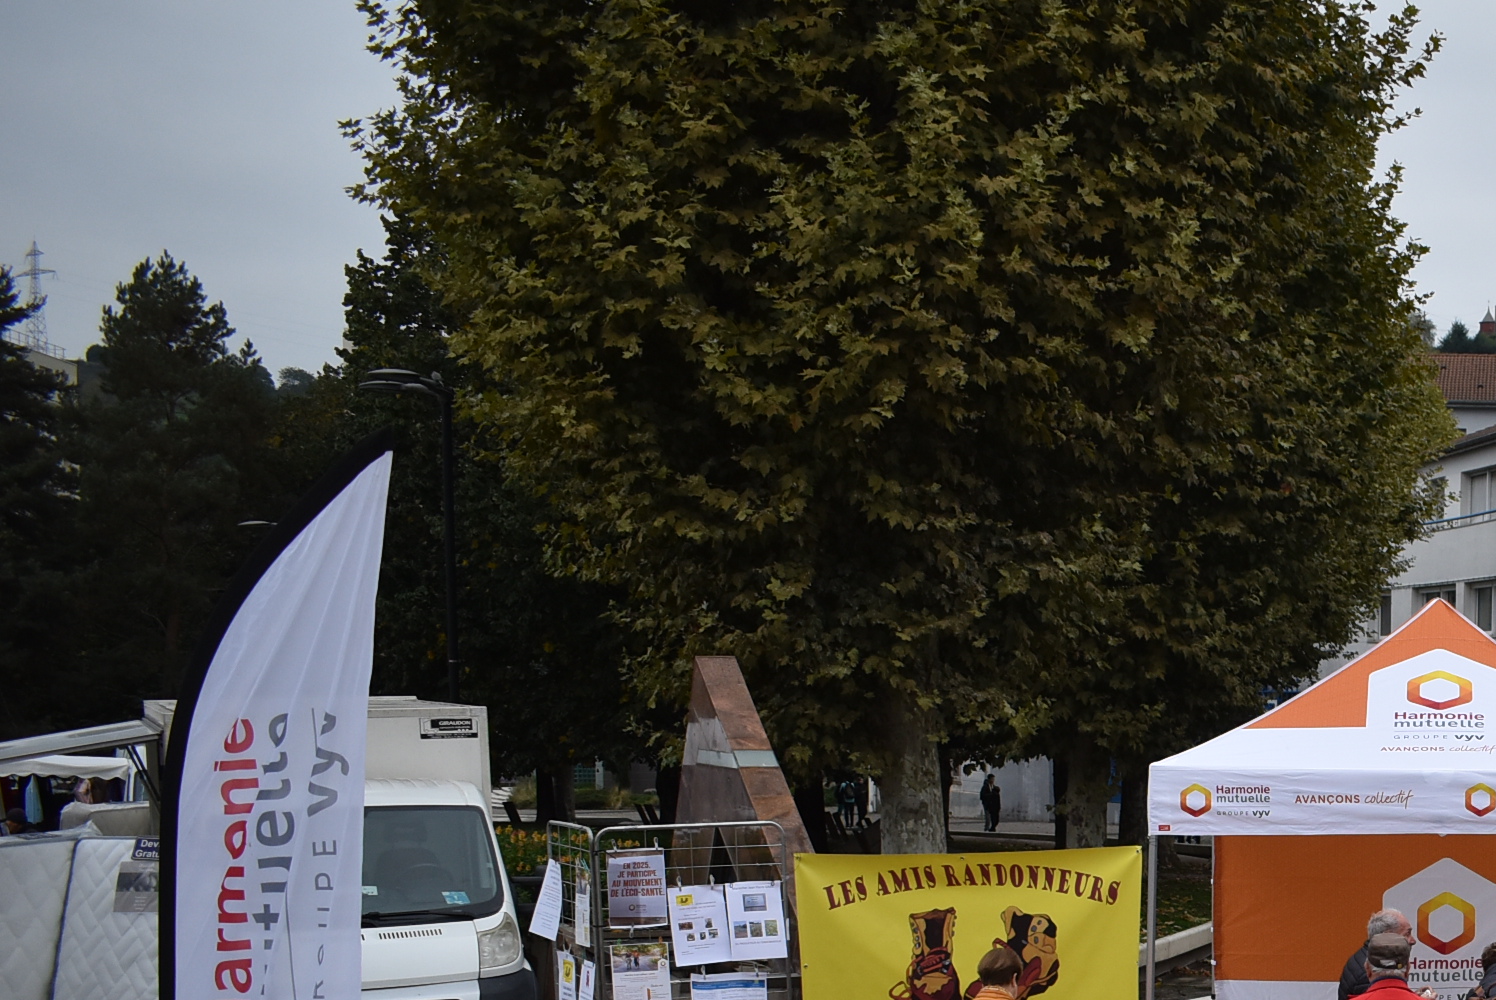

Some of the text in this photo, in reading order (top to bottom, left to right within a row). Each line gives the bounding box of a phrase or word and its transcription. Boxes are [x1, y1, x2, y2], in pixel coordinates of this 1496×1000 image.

[1394, 711, 1485, 720] Harmonie
[1393, 720, 1485, 728] mutuelle
[1454, 734, 1485, 742] vyv
[1215, 784, 1271, 795] Harmonie
[1216, 793, 1271, 803] mutuelle
[1294, 789, 1415, 810] AVANÇONS collectif
[1252, 809, 1271, 819] vyv
[623, 862, 631, 870] EN
[617, 869, 658, 879] JE PARTICIPE
[611, 877, 663, 888] AU MOUVEMENT
[822, 862, 1122, 911] LES AMIS RANDONNEURS
[610, 888, 619, 898] DE
[1409, 956, 1484, 970] Harmonie
[1407, 969, 1484, 982] mutuelle
